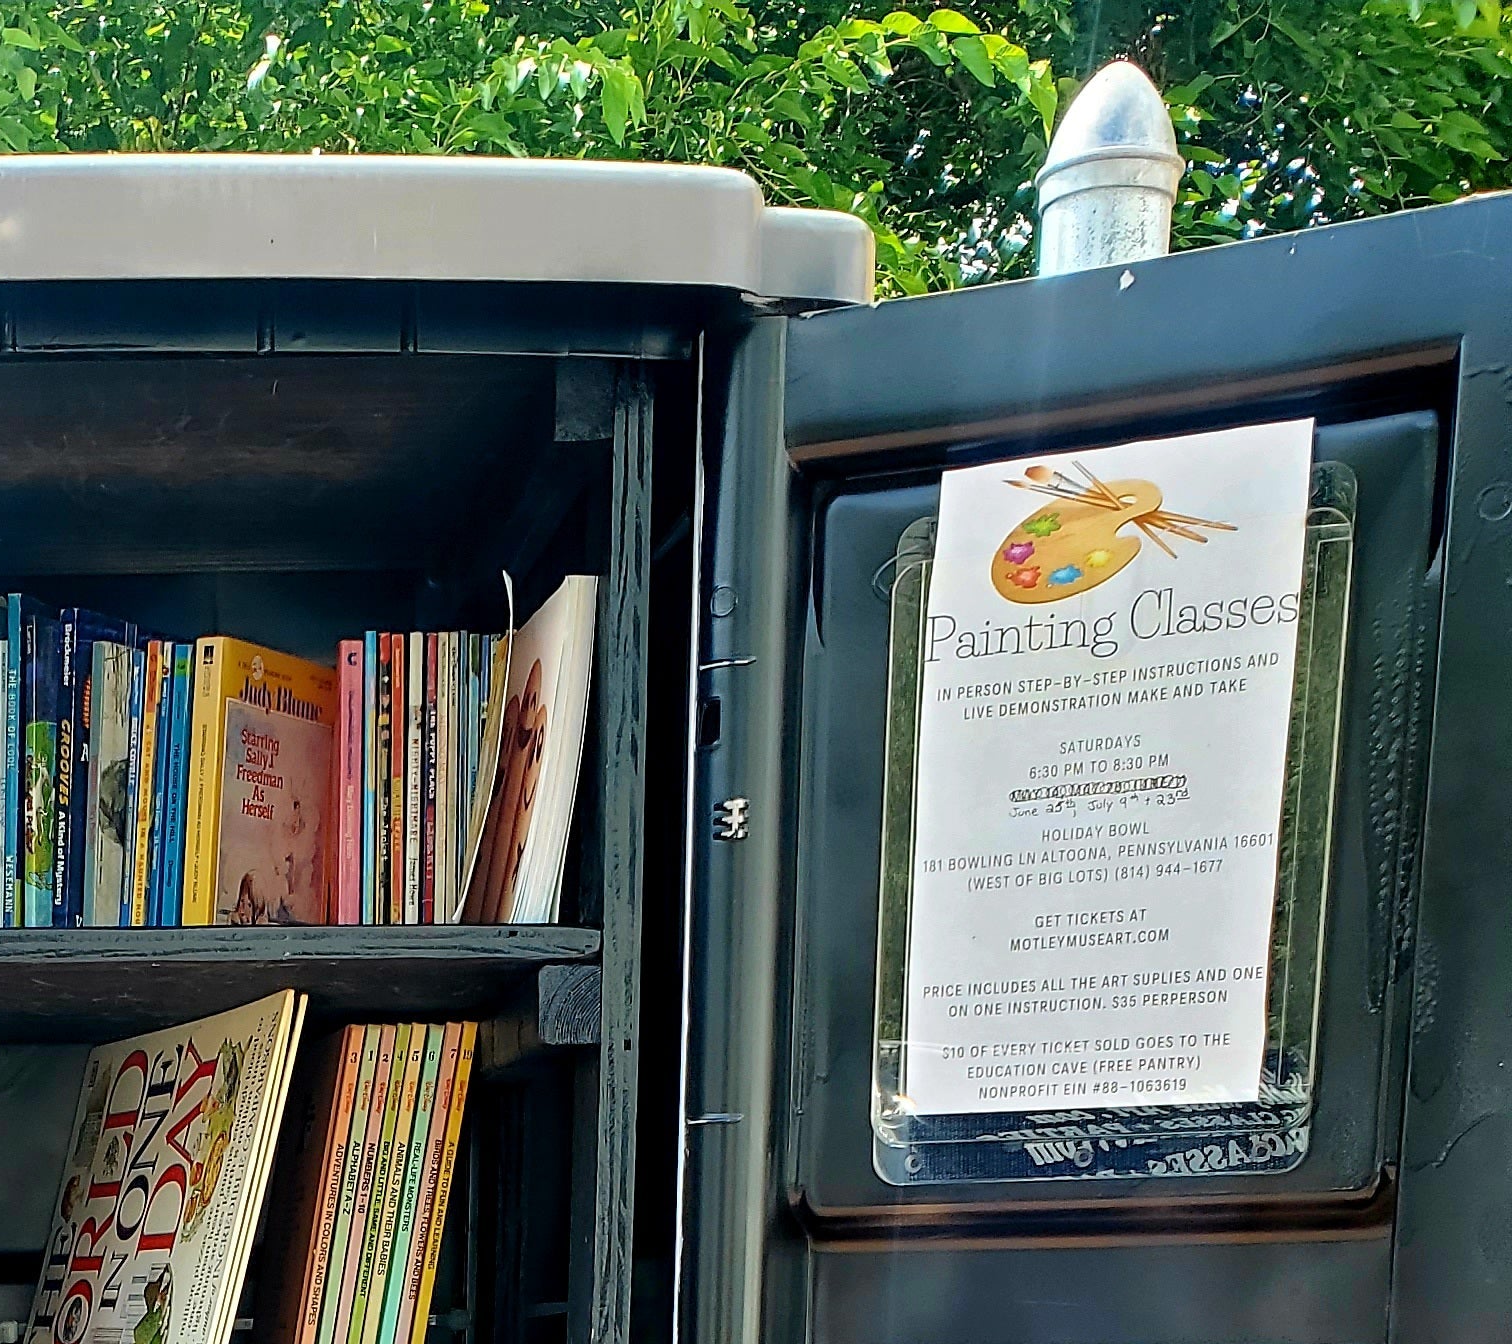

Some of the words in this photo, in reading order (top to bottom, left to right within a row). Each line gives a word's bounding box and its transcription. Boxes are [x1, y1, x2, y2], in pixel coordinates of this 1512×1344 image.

[925, 610, 1118, 663] Painting
[1130, 587, 1300, 639] Classes
[64, 624, 72, 686] Brockmeier
[8, 669, 16, 690] THE
[937, 689, 951, 702] IN
[958, 683, 1012, 699] PERSON
[1018, 670, 1127, 694] STEP-BY-STEP
[1133, 657, 1242, 681] INSTRUCTIONS
[1247, 652, 1279, 668] AND
[7, 694, 15, 723] BOOK
[964, 705, 993, 720] LIVE
[999, 693, 1121, 717] DEMONSTRATION
[1128, 688, 1168, 704] MAKE
[1173, 684, 1203, 699] AND
[1210, 679, 1247, 693] TAKE
[7, 727, 14, 741] OF
[242, 729, 280, 756] Starring
[1060, 734, 1141, 754] SATURDAYS
[59, 718, 70, 806] GROOVES
[246, 748, 268, 770] Sally
[1029, 764, 1058, 779] 6:30
[1064, 761, 1084, 776] PM
[1090, 760, 1107, 774] TO
[1113, 756, 1143, 771] 8:30
[1149, 754, 1169, 768] PM
[237, 765, 283, 790] Freedman
[252, 785, 264, 802] As
[242, 798, 274, 820] Herself
[1042, 826, 1103, 842] HOLIDAY
[1108, 821, 1149, 837] BOWL
[1035, 914, 1060, 928] GET
[1067, 911, 1123, 926] TICKETS
[1130, 909, 1147, 921] AT
[1010, 929, 1169, 952] MOTLEYMUSEART.COM
[967, 1062, 1046, 1079] EDUCATION
[1051, 1060, 1087, 1075] CAVE
[1093, 1059, 1132, 1074] (FREE
[1138, 1056, 1201, 1072] PANTRY)
[978, 1083, 1058, 1100] NONPROFIT
[1064, 1082, 1086, 1095] EIN
[1092, 1078, 1187, 1094] #88-1063619
[137, 1037, 219, 1259] DAY
[99, 1246, 129, 1313] IN
[115, 1044, 184, 1241] ONE
[348, 1141, 360, 1196] ALPHABET
[361, 1142, 375, 1190] NUMBERS
